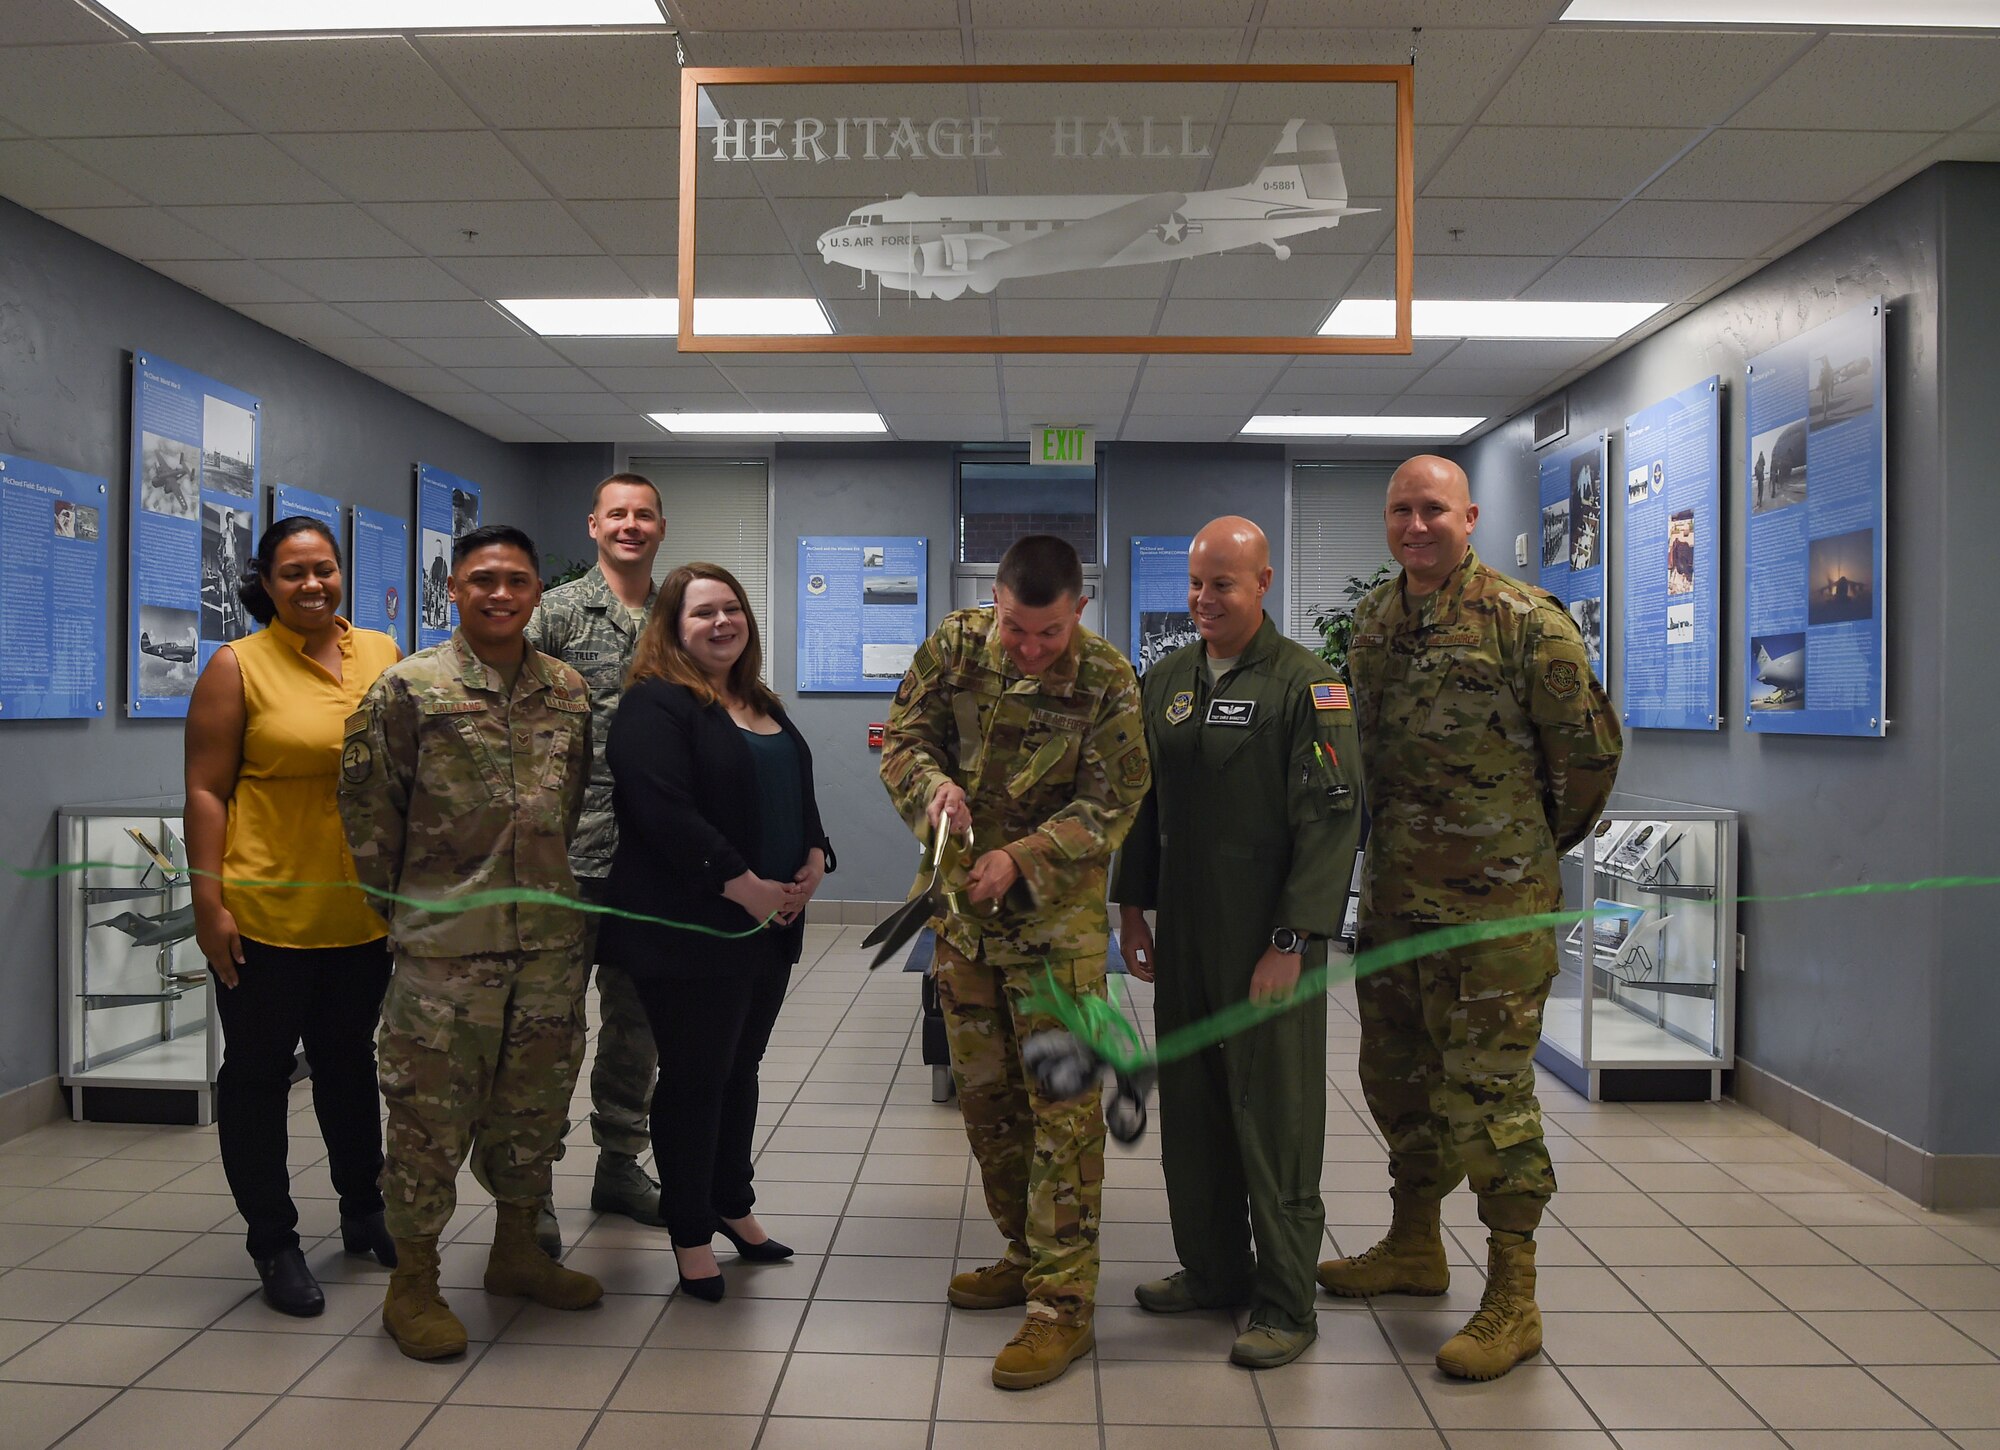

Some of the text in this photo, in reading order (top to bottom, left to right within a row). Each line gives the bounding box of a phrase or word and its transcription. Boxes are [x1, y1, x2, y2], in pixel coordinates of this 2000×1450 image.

[711, 114, 1212, 164] HERITAGE HALL
[881, 234, 920, 246] FORCE
[1043, 428, 1086, 461] EXIT
[574, 651, 599, 661] TILLEY
